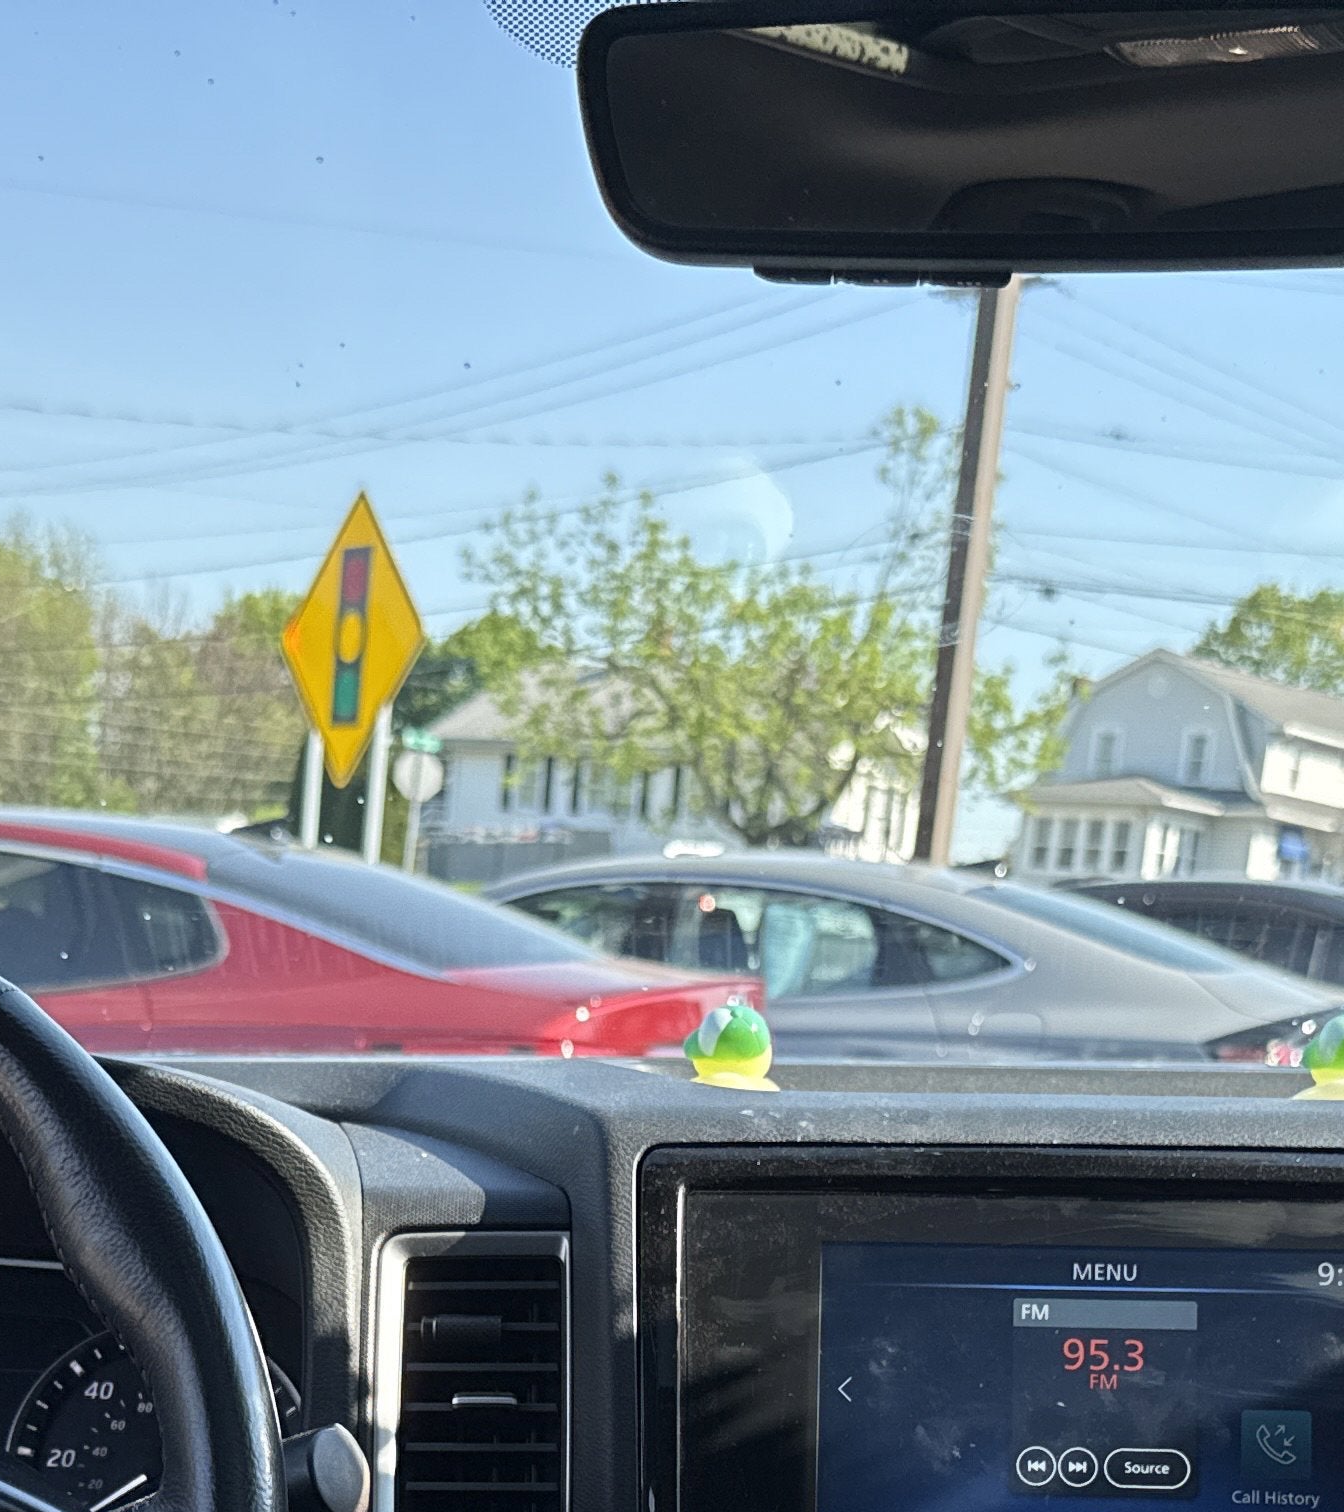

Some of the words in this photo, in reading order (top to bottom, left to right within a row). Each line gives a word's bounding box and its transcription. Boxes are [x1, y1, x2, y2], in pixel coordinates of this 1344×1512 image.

[1072, 1261, 1139, 1283] MENU
[1020, 1302, 1051, 1322] FM
[1061, 1338, 1146, 1373] 95.3
[84, 1380, 114, 1401] 40
[1089, 1373, 1118, 1390] FM
[110, 1419, 126, 1431] 60
[46, 1449, 76, 1467] 20
[91, 1446, 108, 1457] 40
[1124, 1461, 1170, 1476] Source
[87, 1479, 103, 1489] 20
[1232, 1490, 1259, 1505] Call
[1264, 1490, 1321, 1509] History
